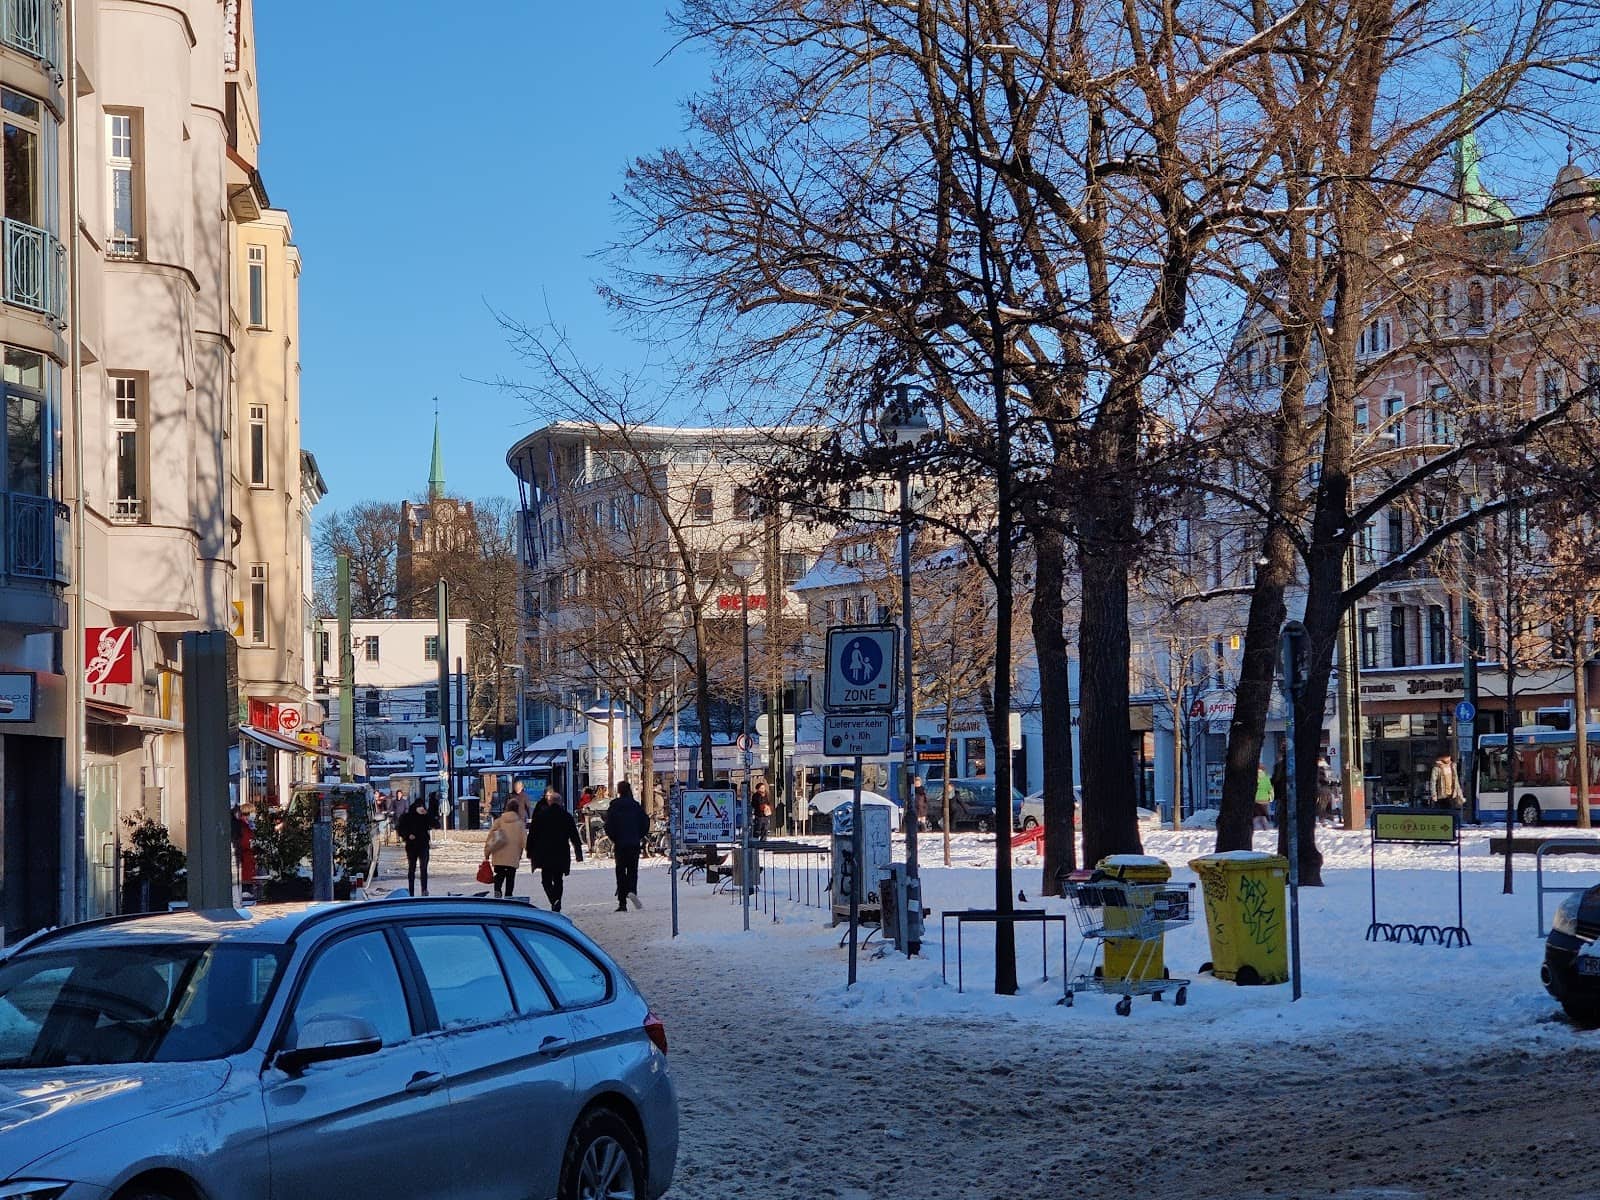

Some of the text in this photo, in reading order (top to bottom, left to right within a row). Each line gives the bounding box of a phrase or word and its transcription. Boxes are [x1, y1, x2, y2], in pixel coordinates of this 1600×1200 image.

[844, 688, 877, 702] ZONE
[1209, 703, 1236, 713] APOTHE
[829, 719, 883, 729] Lieferverkehr
[849, 743, 863, 752] frei
